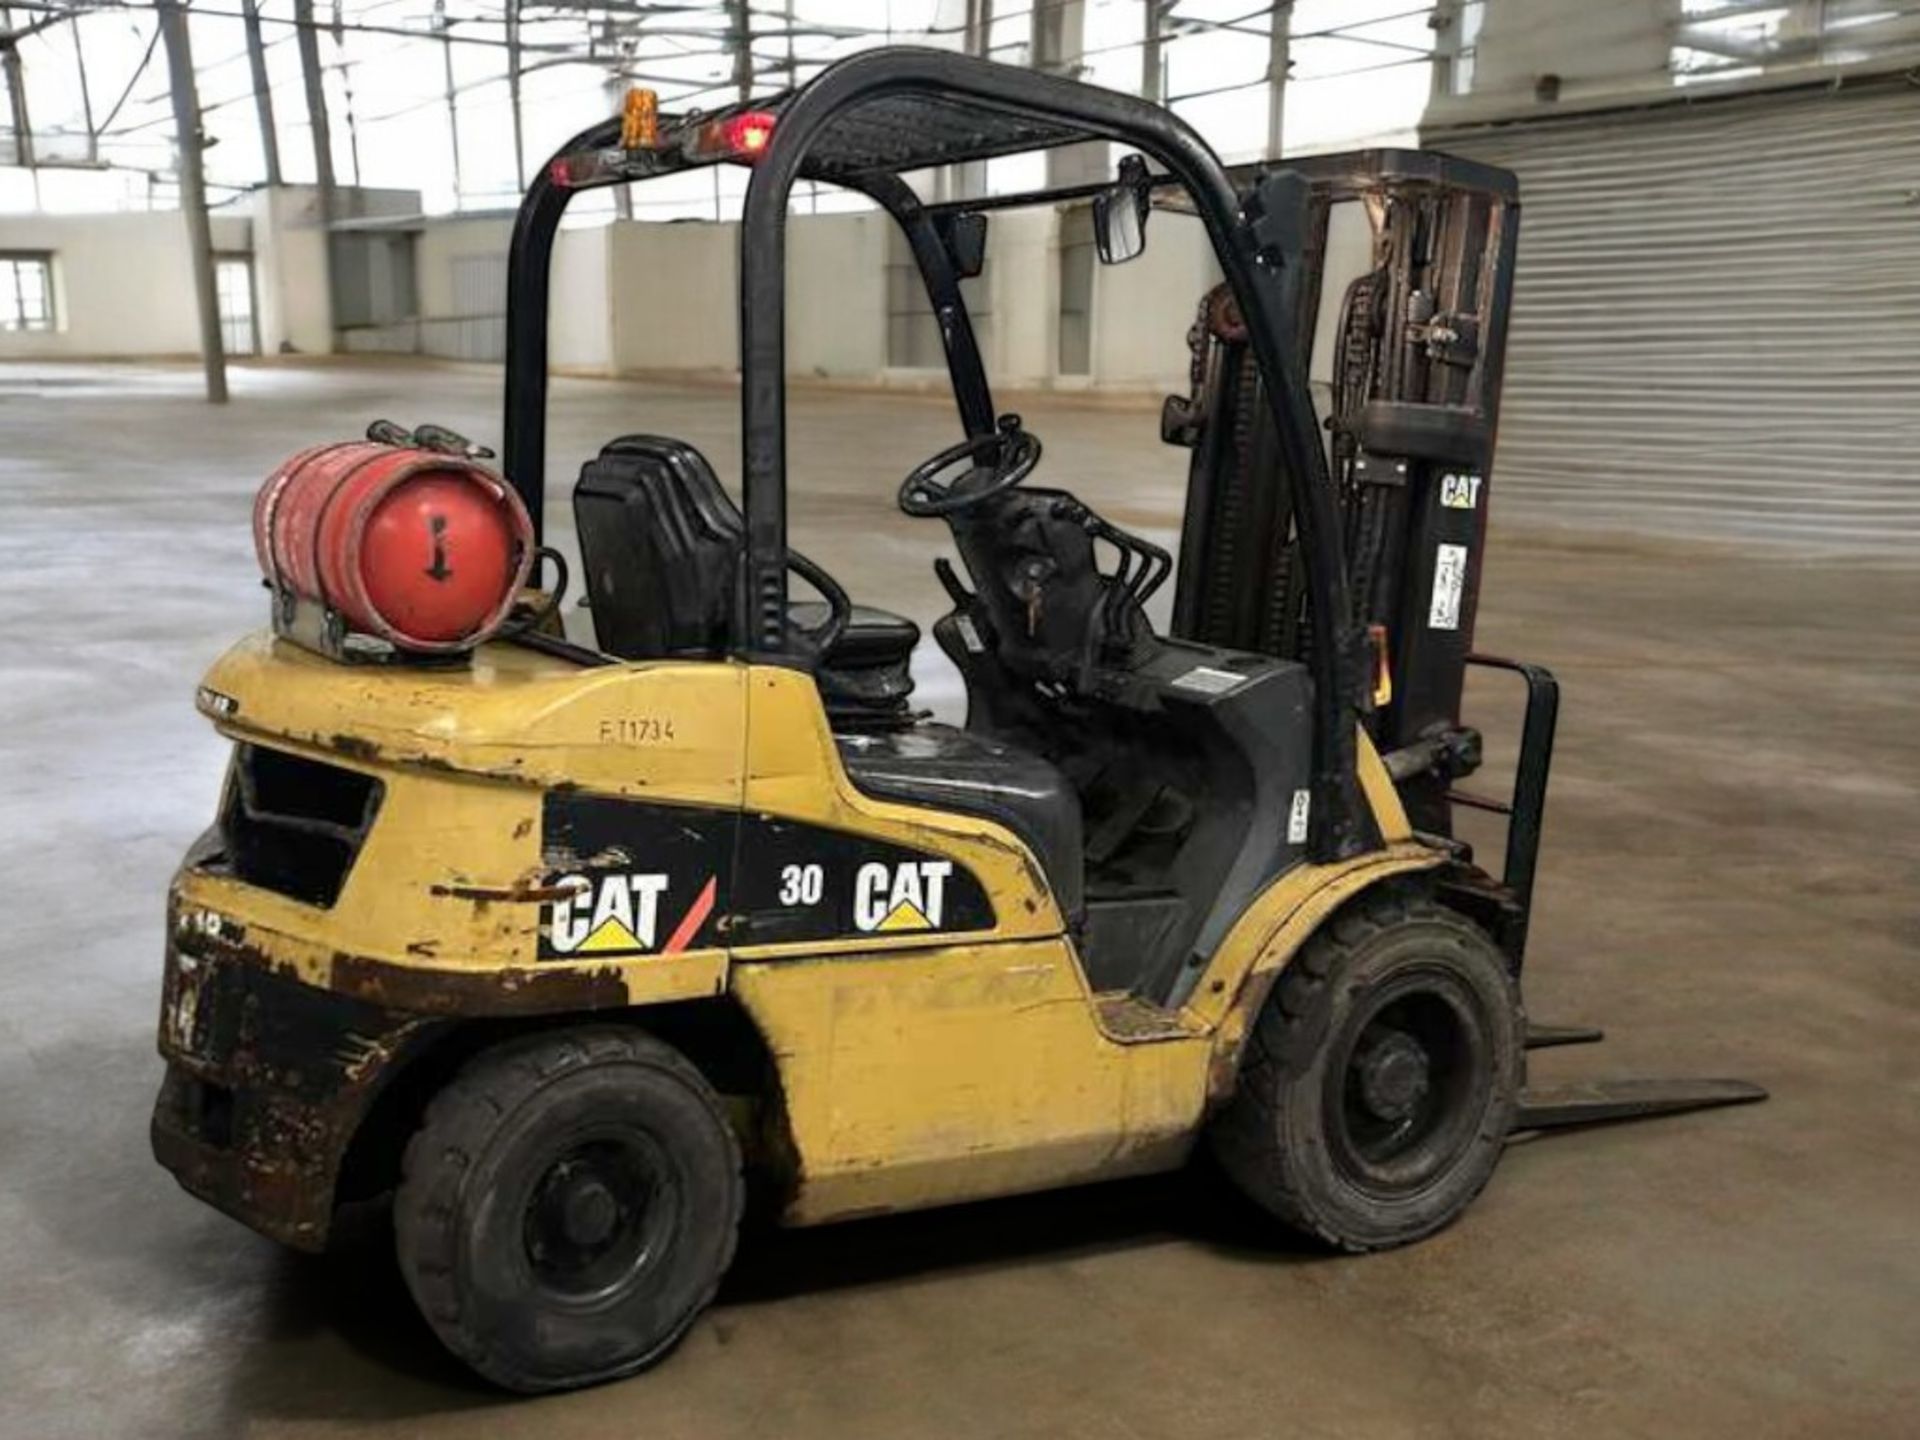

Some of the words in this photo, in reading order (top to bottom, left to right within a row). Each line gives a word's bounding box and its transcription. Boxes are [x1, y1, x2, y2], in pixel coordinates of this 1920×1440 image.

[1440, 474, 1482, 508] CAT
[551, 873, 669, 953] CAT
[779, 864, 824, 906] 30
[853, 861, 952, 932] CAT
